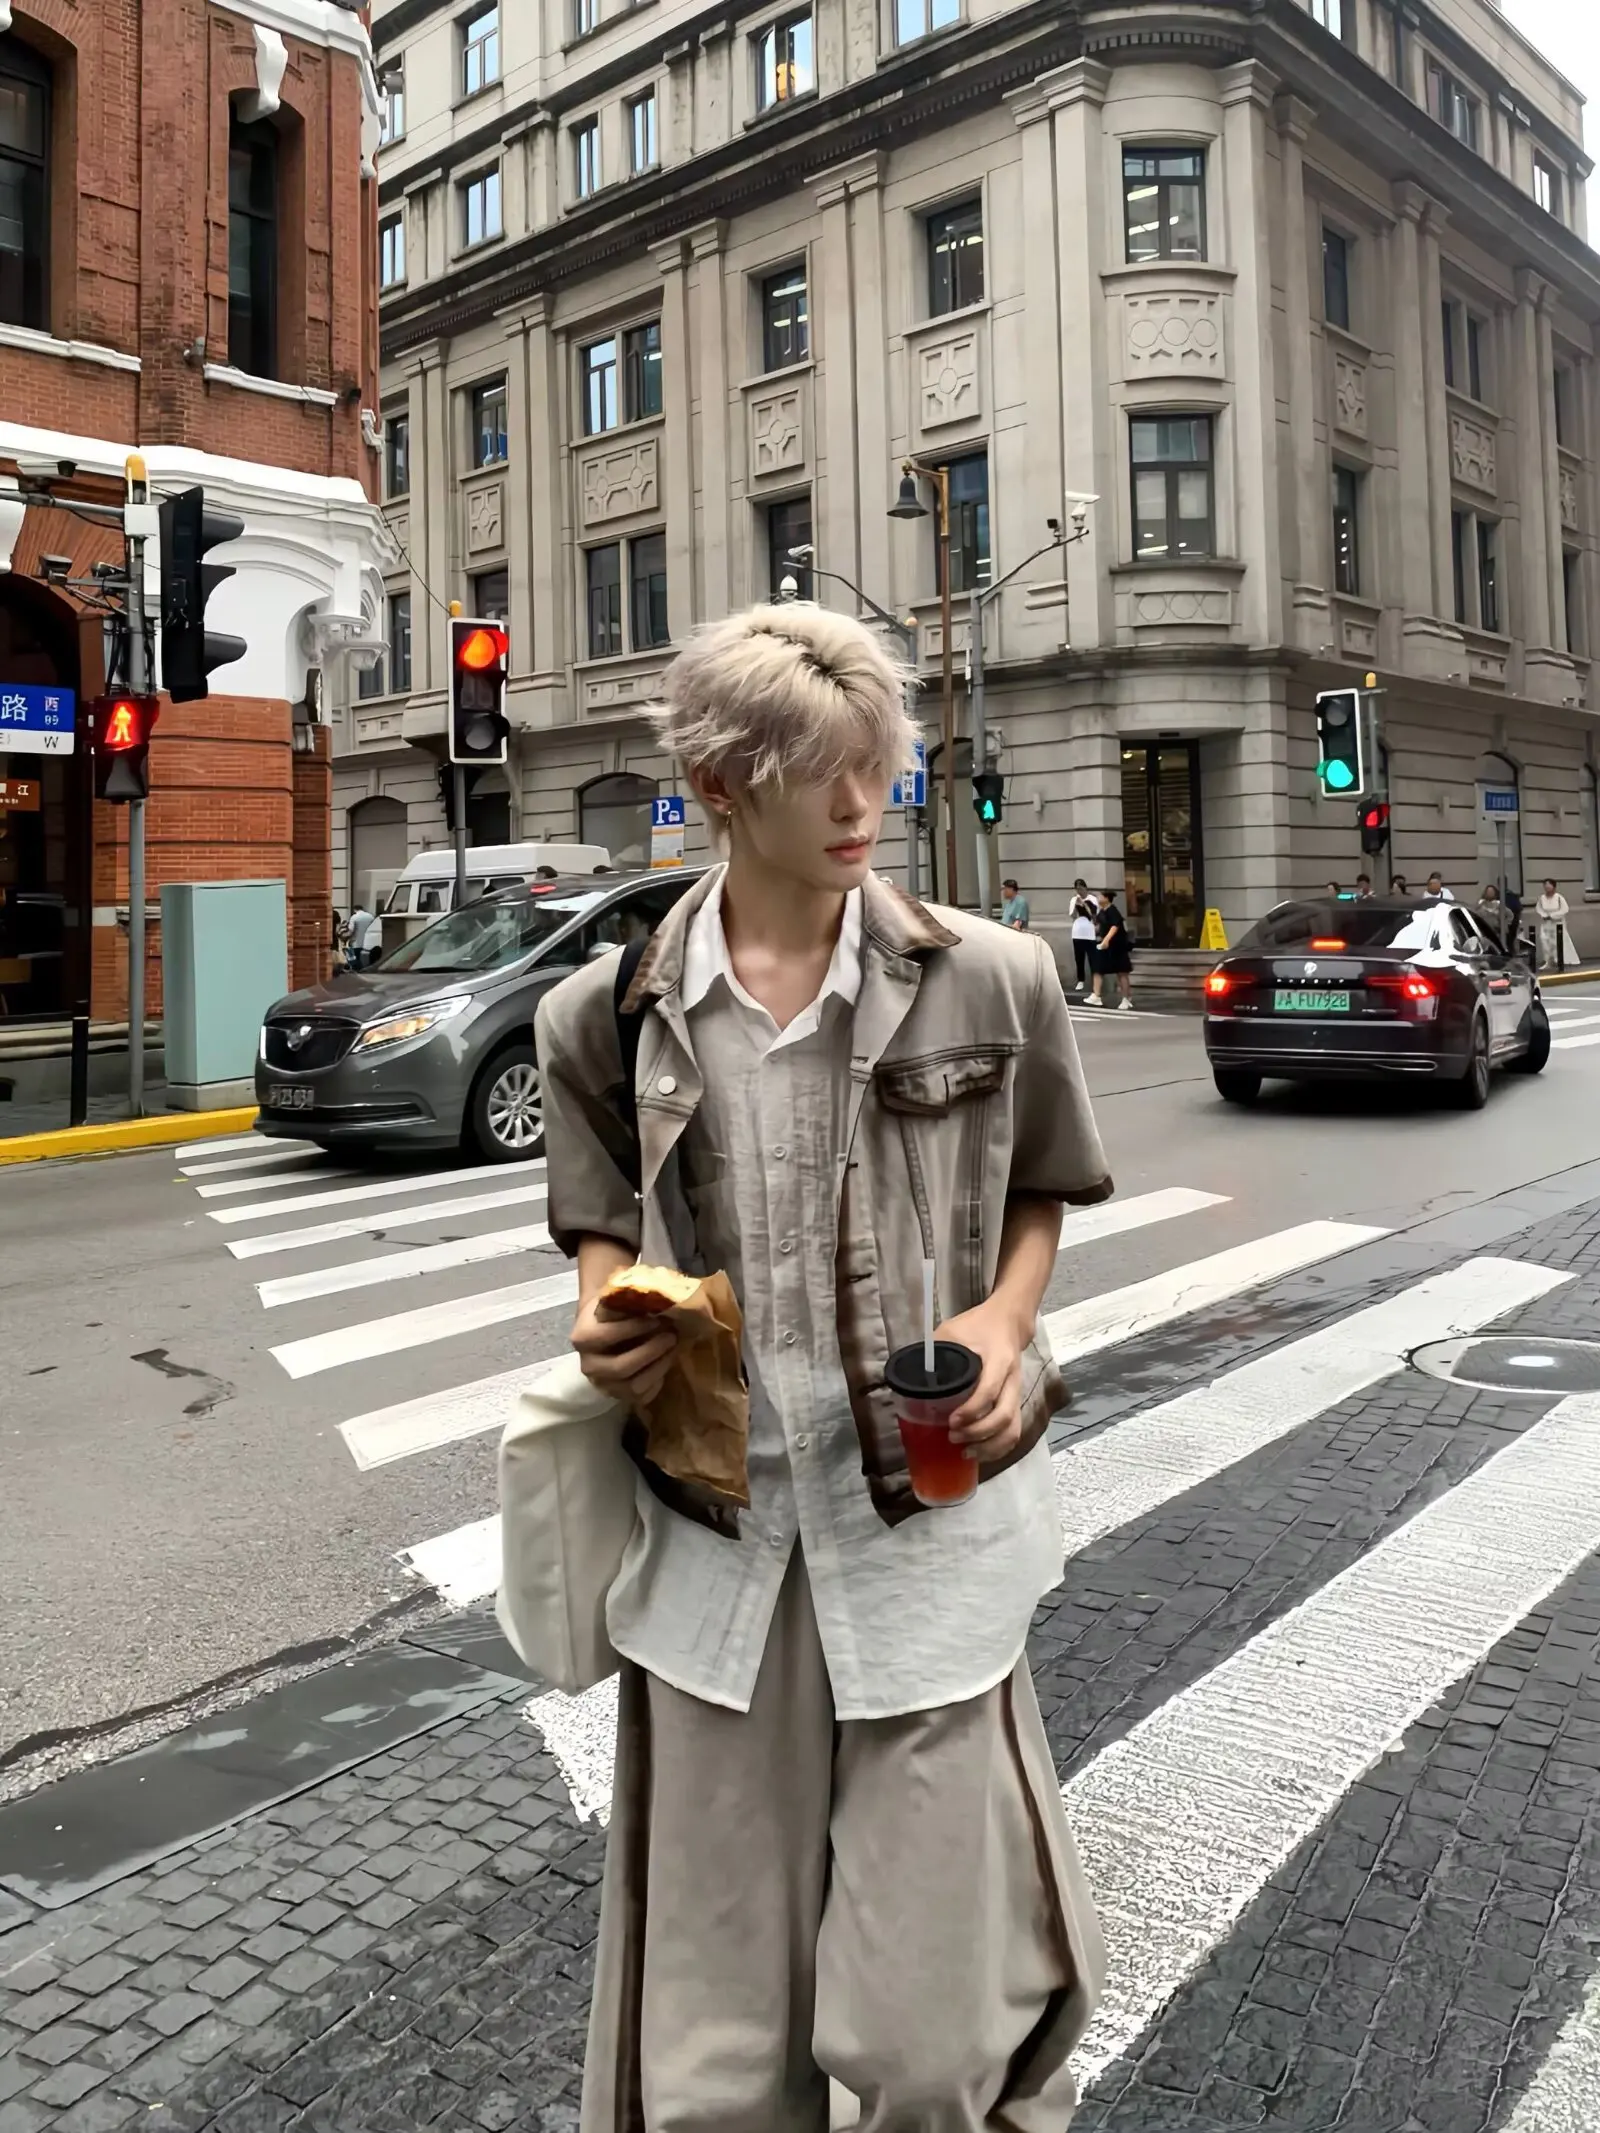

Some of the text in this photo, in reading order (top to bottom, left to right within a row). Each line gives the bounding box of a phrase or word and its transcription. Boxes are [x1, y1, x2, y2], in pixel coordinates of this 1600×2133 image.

[1, 693, 28, 721] 路
[44, 696, 60, 712] 西
[44, 736, 59, 748] W
[656, 799, 671, 824] P
